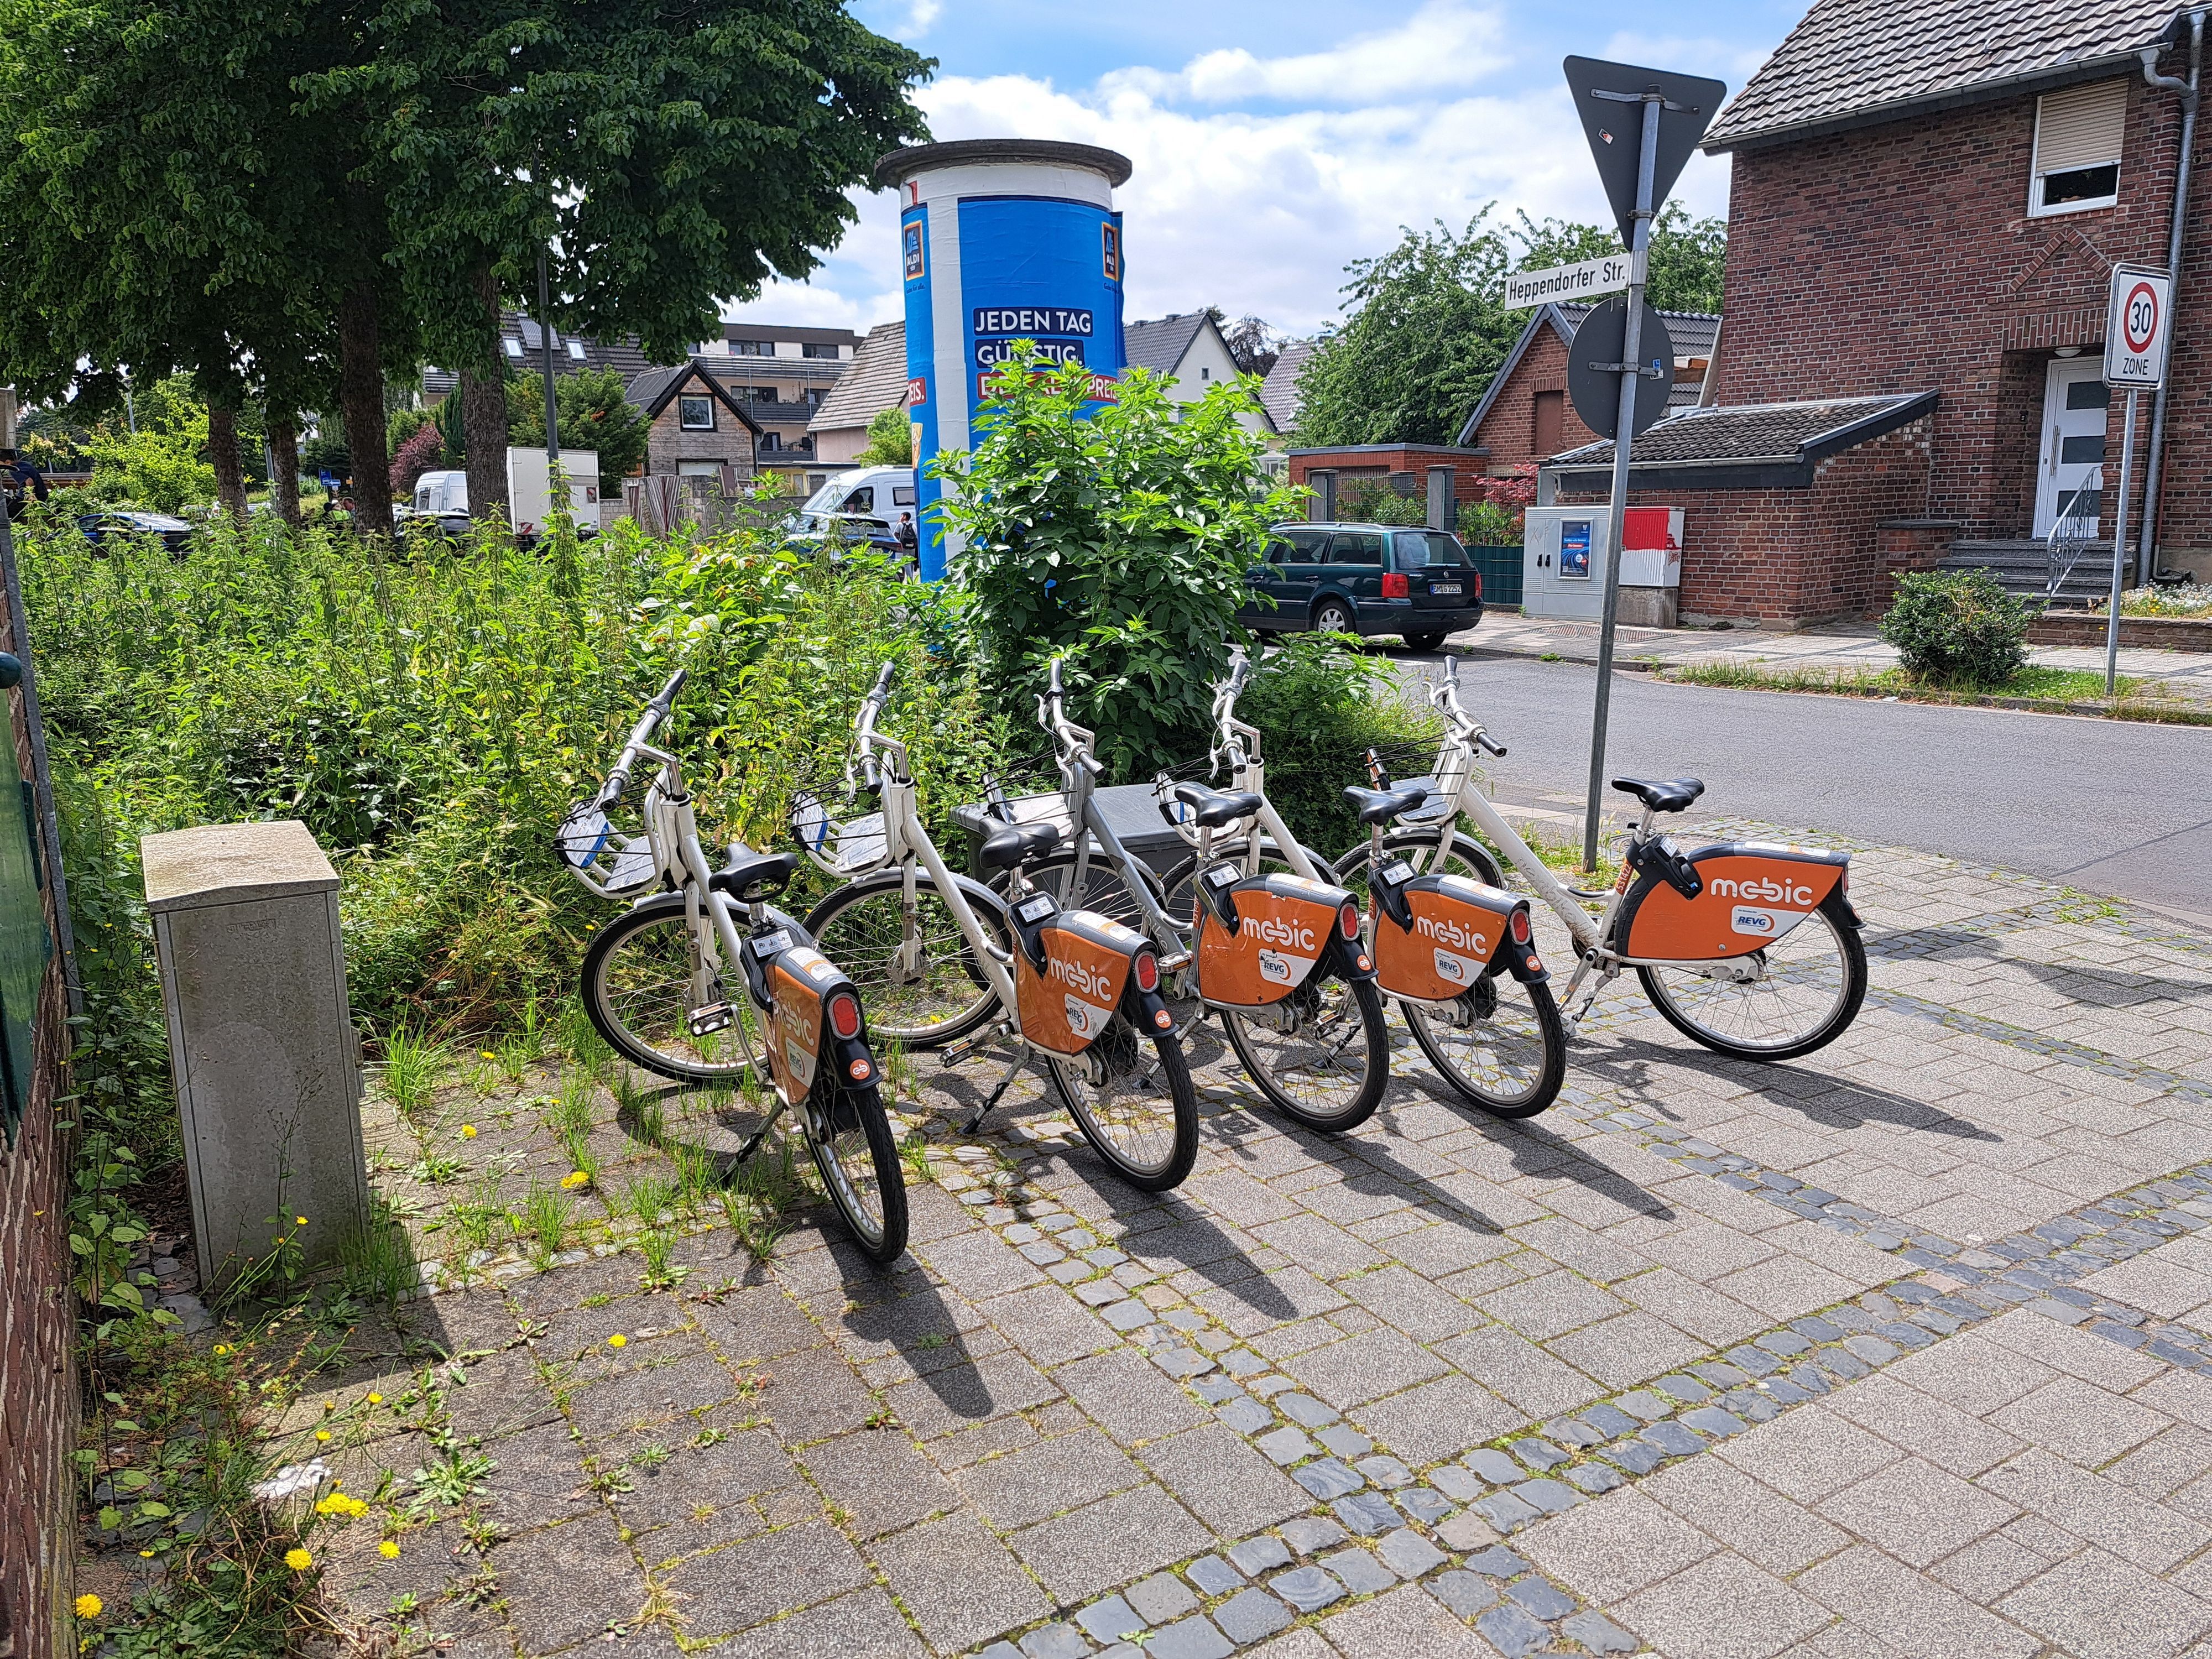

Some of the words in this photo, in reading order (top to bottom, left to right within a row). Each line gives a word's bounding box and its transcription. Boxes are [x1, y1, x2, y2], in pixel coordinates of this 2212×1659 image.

[907, 253, 920, 267] ALDI
[1509, 267, 1595, 303] Heppendorfer
[1603, 262, 1625, 284] Str.
[975, 310, 1050, 332] JEDEN
[1056, 311, 1091, 333] TAG
[2130, 301, 2152, 335] 30
[2122, 357, 2150, 376] ZONE
[1448, 585, 1462, 593] 2252
[1616, 863, 1632, 891] 531422
[1711, 877, 1813, 906] mobic
[1121, 875, 1169, 952] nextbike
[1738, 916, 1767, 926] REVG
[1243, 916, 1316, 951] mobic
[1417, 915, 1487, 956] mobic
[1264, 962, 1285, 973] REVG
[1439, 959, 1458, 973] REVG
[1050, 956, 1112, 1002] mobic
[790, 1052, 802, 1069] REVG
